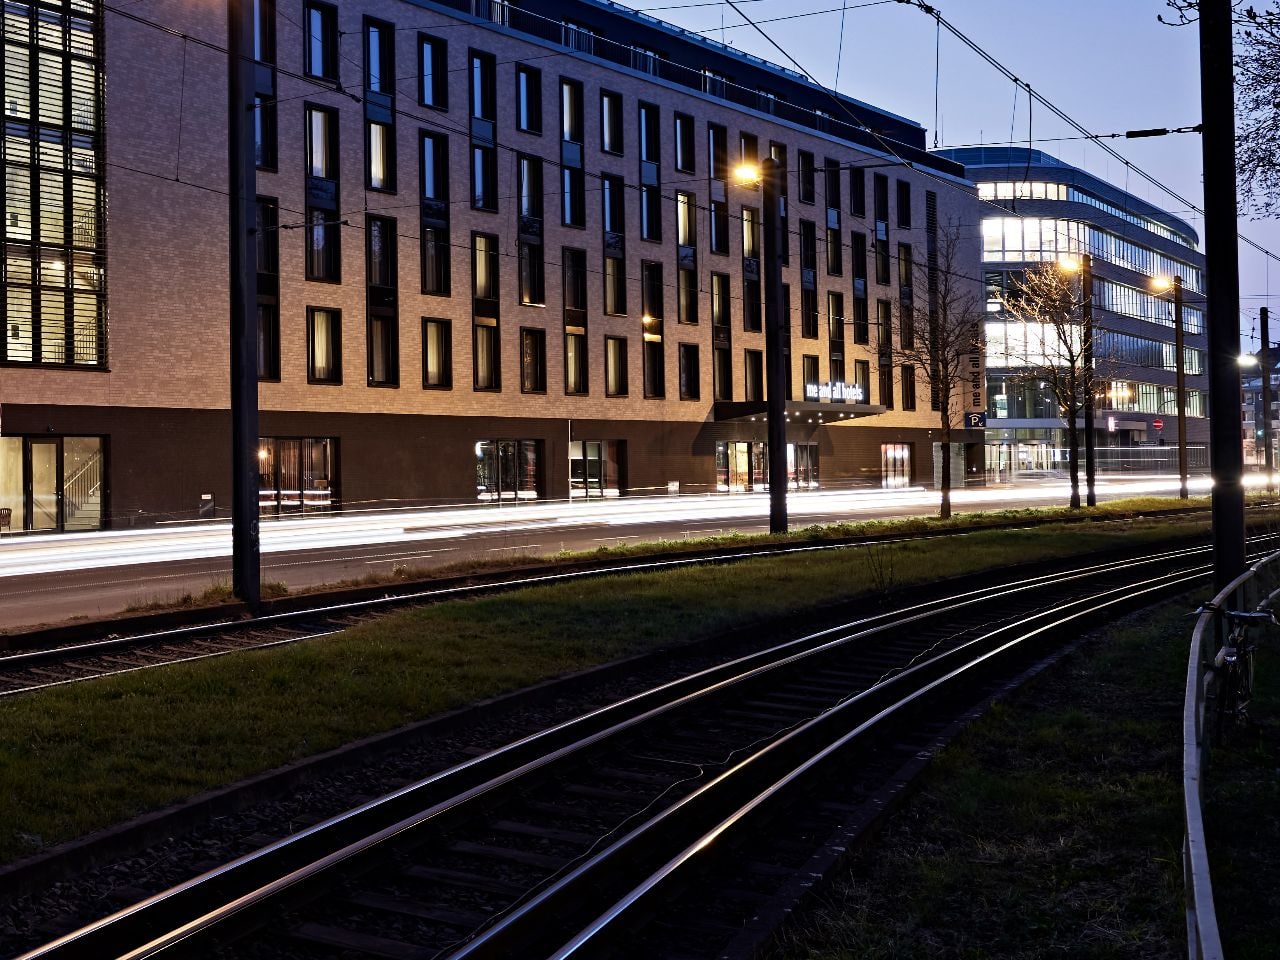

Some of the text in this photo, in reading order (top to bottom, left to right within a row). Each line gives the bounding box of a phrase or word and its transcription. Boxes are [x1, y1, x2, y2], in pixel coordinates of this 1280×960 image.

[969, 356, 980, 368] all
[969, 371, 980, 389] and
[806, 382, 863, 400] me and all hotels
[972, 393, 980, 406] me
[971, 416, 979, 426] P
